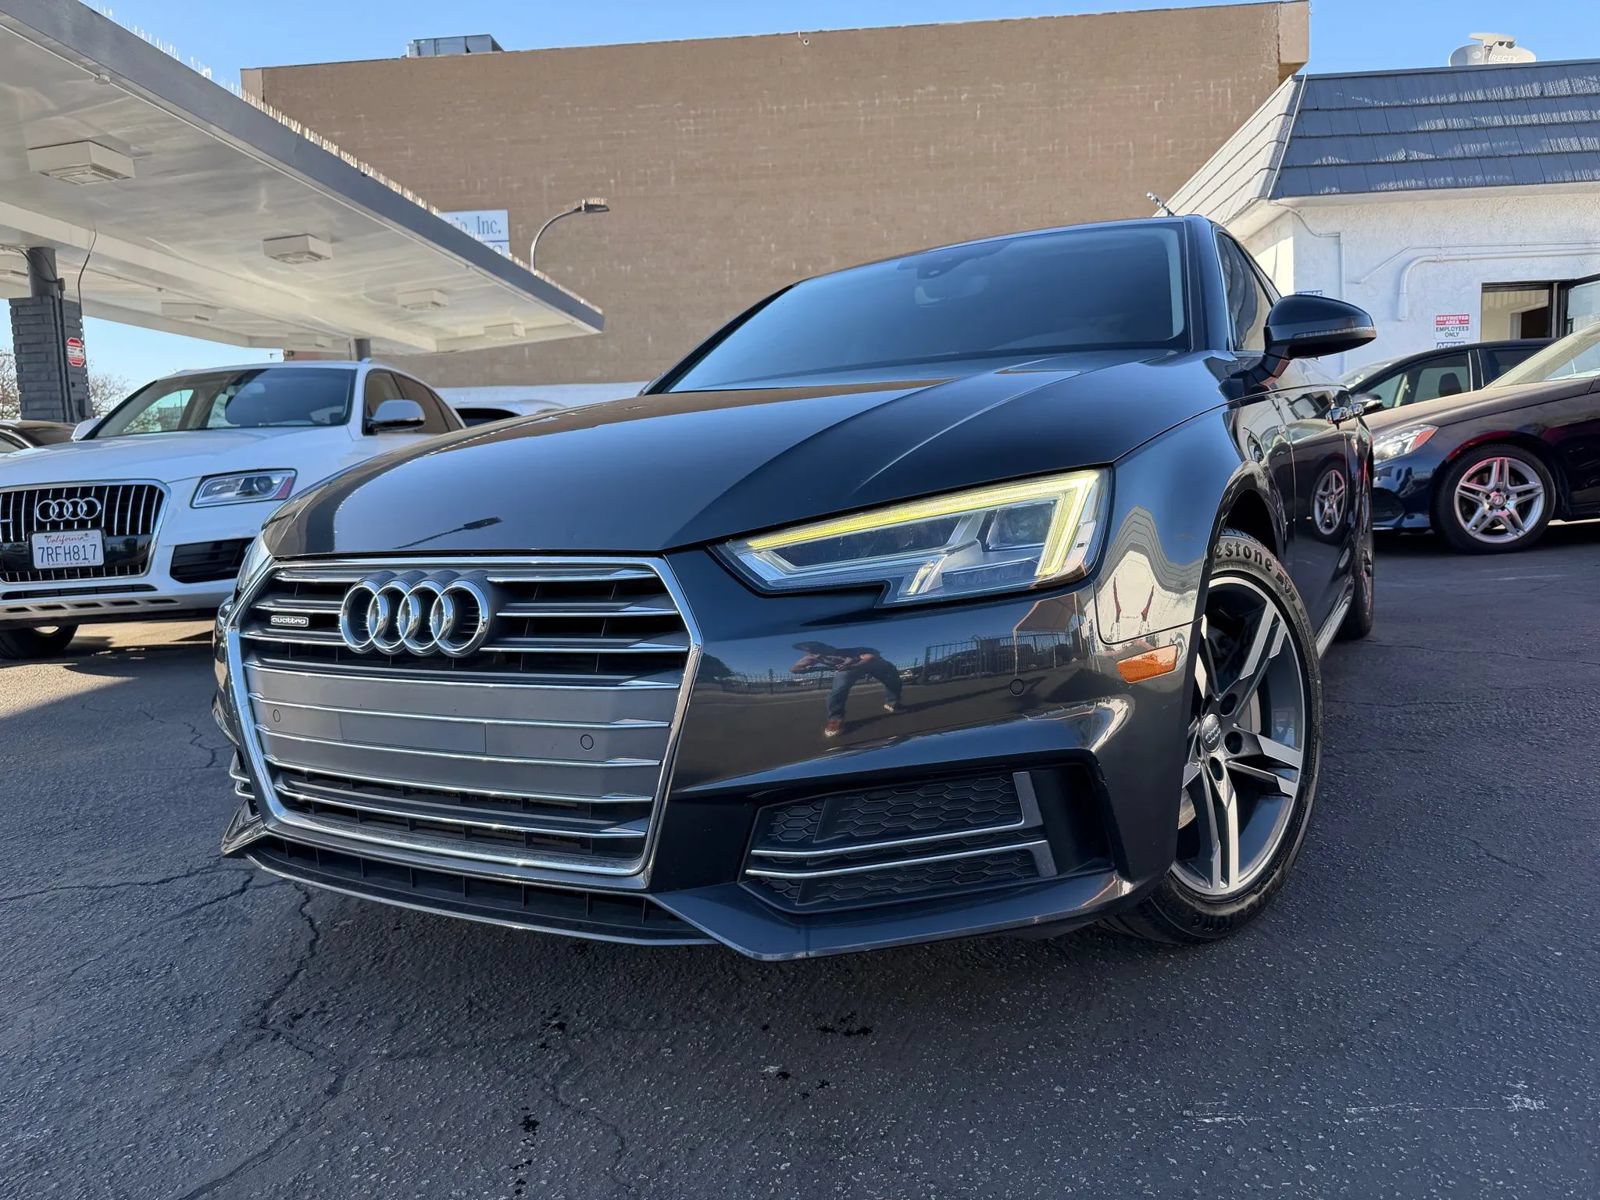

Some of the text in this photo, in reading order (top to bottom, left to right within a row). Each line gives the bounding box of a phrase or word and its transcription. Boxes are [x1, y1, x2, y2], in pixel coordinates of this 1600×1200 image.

[476, 215, 502, 235] Inc.
[38, 543, 97, 563] 7RFH817
[1214, 541, 1273, 572] estone
[271, 617, 306, 625] quattro
